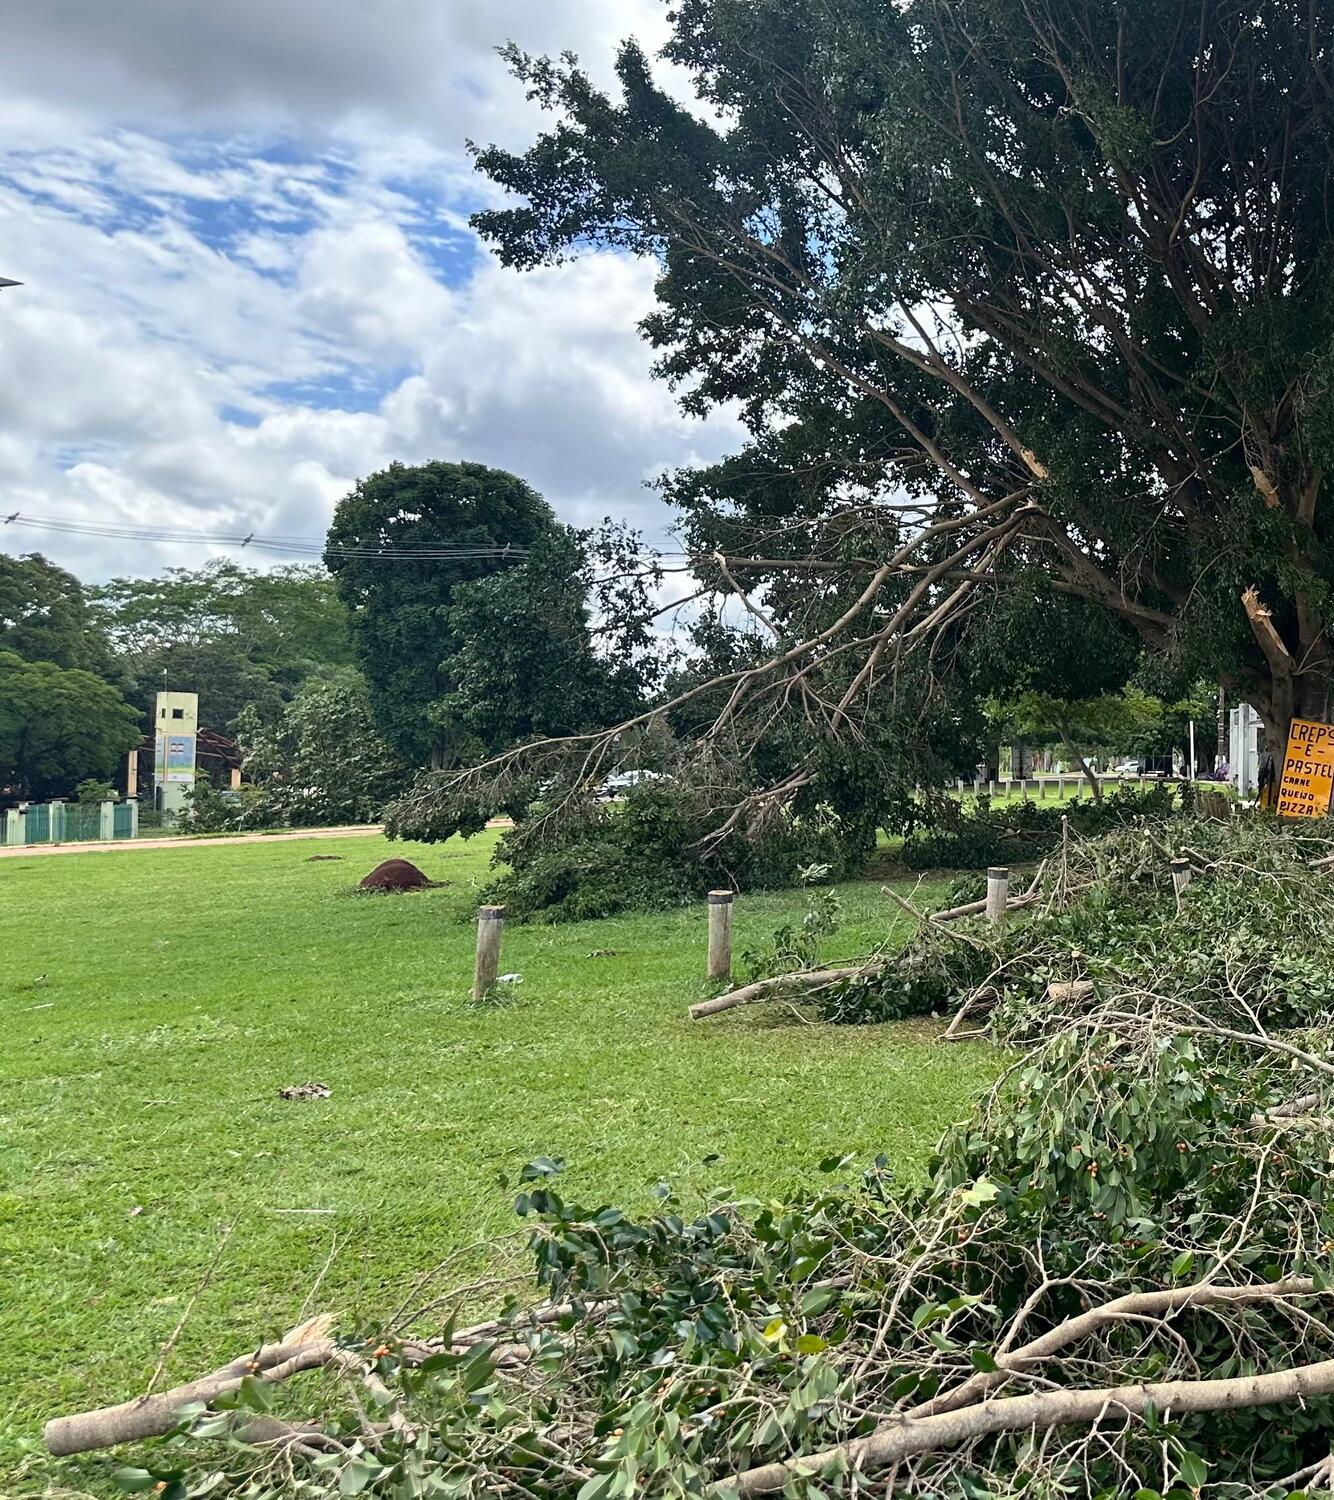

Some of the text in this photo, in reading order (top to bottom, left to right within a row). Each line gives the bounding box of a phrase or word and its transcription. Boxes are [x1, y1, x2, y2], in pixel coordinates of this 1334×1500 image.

[1286, 758, 1332, 778] PASTEL
[1283, 776, 1310, 787] CARNE
[1281, 788, 1314, 801] QUEIJO
[1280, 801, 1314, 815] PIZZA
